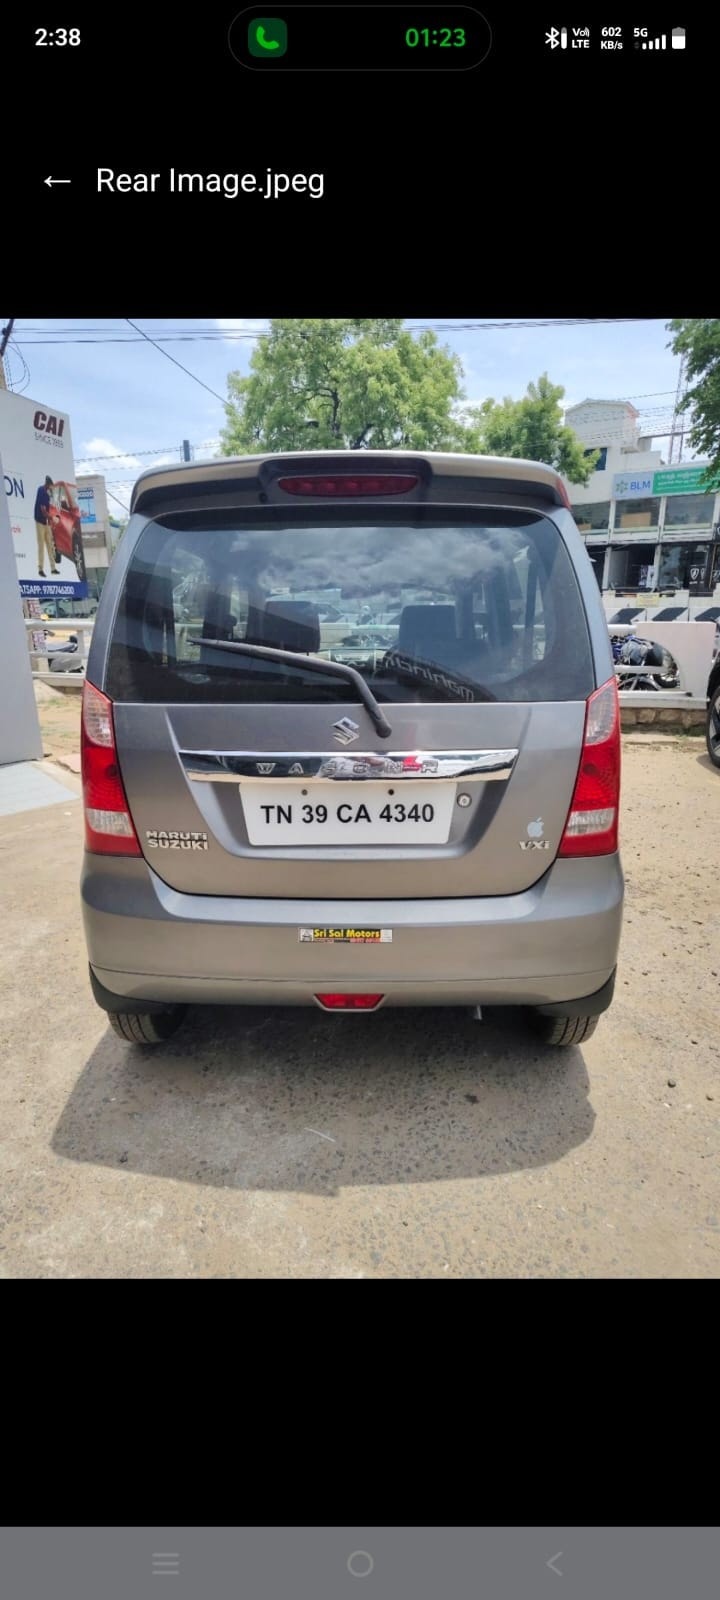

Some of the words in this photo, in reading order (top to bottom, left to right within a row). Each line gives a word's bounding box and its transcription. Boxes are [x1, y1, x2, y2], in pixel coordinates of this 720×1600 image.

[33, 410, 65, 438] CAI
[630, 481, 651, 491] BLM
[260, 805, 292, 824] TN
[302, 804, 328, 824] 39
[336, 803, 372, 824] CA
[379, 803, 434, 823] 4340
[147, 839, 208, 850] SUZUKI
[346, 928, 380, 938] Motors
